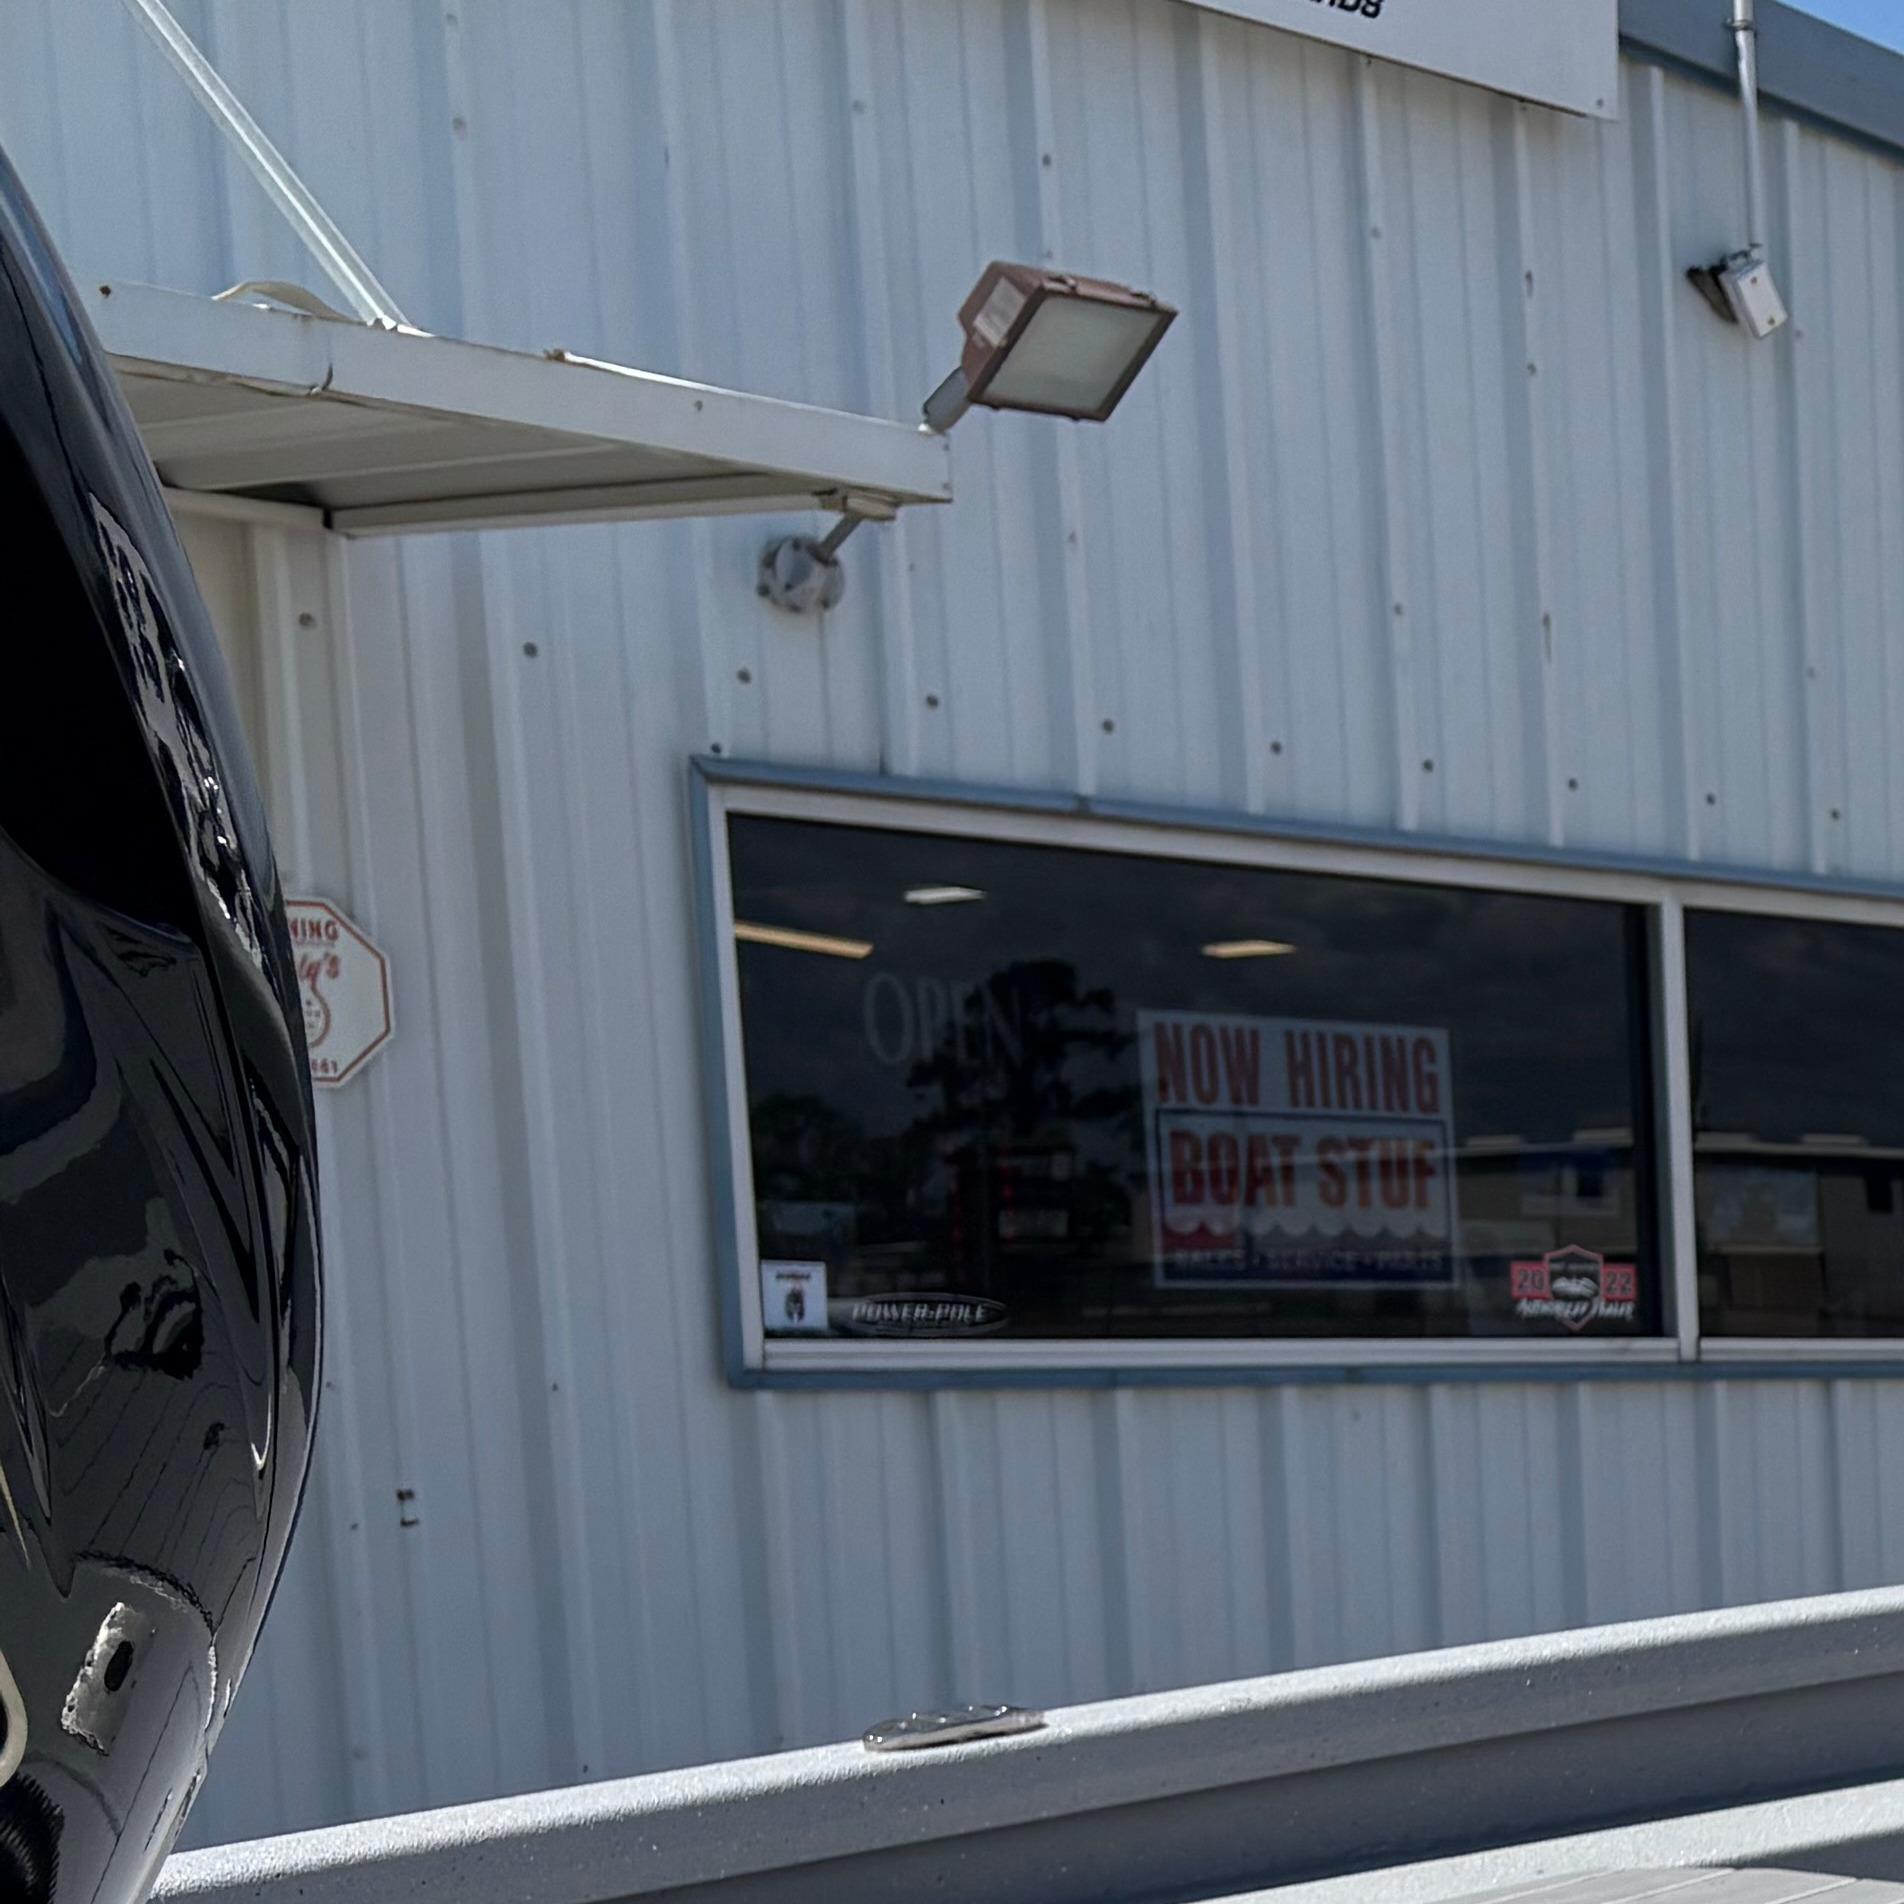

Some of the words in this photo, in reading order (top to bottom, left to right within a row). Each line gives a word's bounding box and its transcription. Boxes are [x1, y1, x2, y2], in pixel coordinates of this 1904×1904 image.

[864, 971, 1025, 1071] OPEN
[1153, 1021, 1261, 1105] NOW
[1284, 1029, 1441, 1113] HIRING
[1168, 1128, 1301, 1207] BOAT
[1315, 1134, 1437, 1211] STUF
